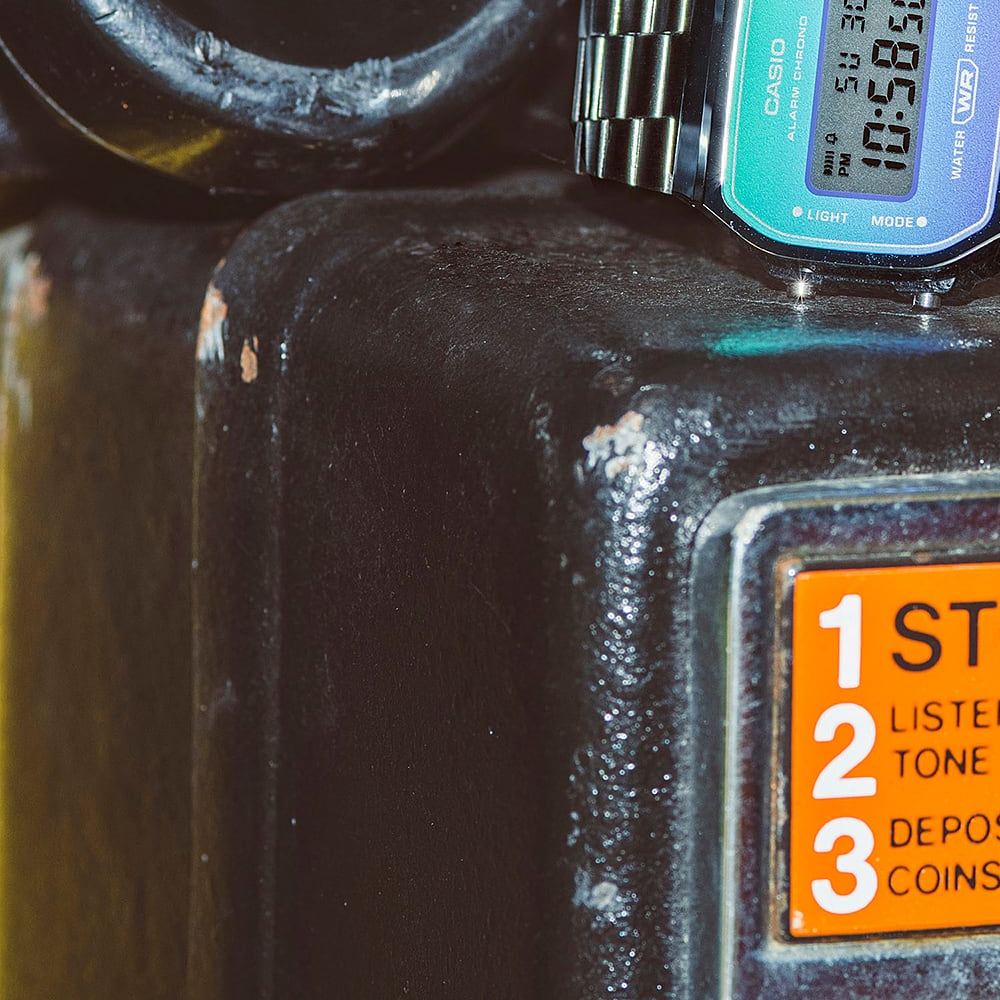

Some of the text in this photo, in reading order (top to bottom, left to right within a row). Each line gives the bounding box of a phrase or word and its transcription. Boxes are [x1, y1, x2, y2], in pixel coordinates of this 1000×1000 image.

[764, 38, 786, 116] CASIO
[787, 16, 808, 141] ALARM CHRONO
[861, 38, 920, 170] 10:58
[950, 3, 979, 180] WATER WR RESIST
[838, 153, 851, 177] PM
[807, 210, 848, 224] LIGHT
[871, 215, 914, 228] MODE
[818, 594, 862, 689] 1
[812, 702, 877, 800] 2
[895, 746, 989, 779] TONE
[811, 816, 878, 915] 3
